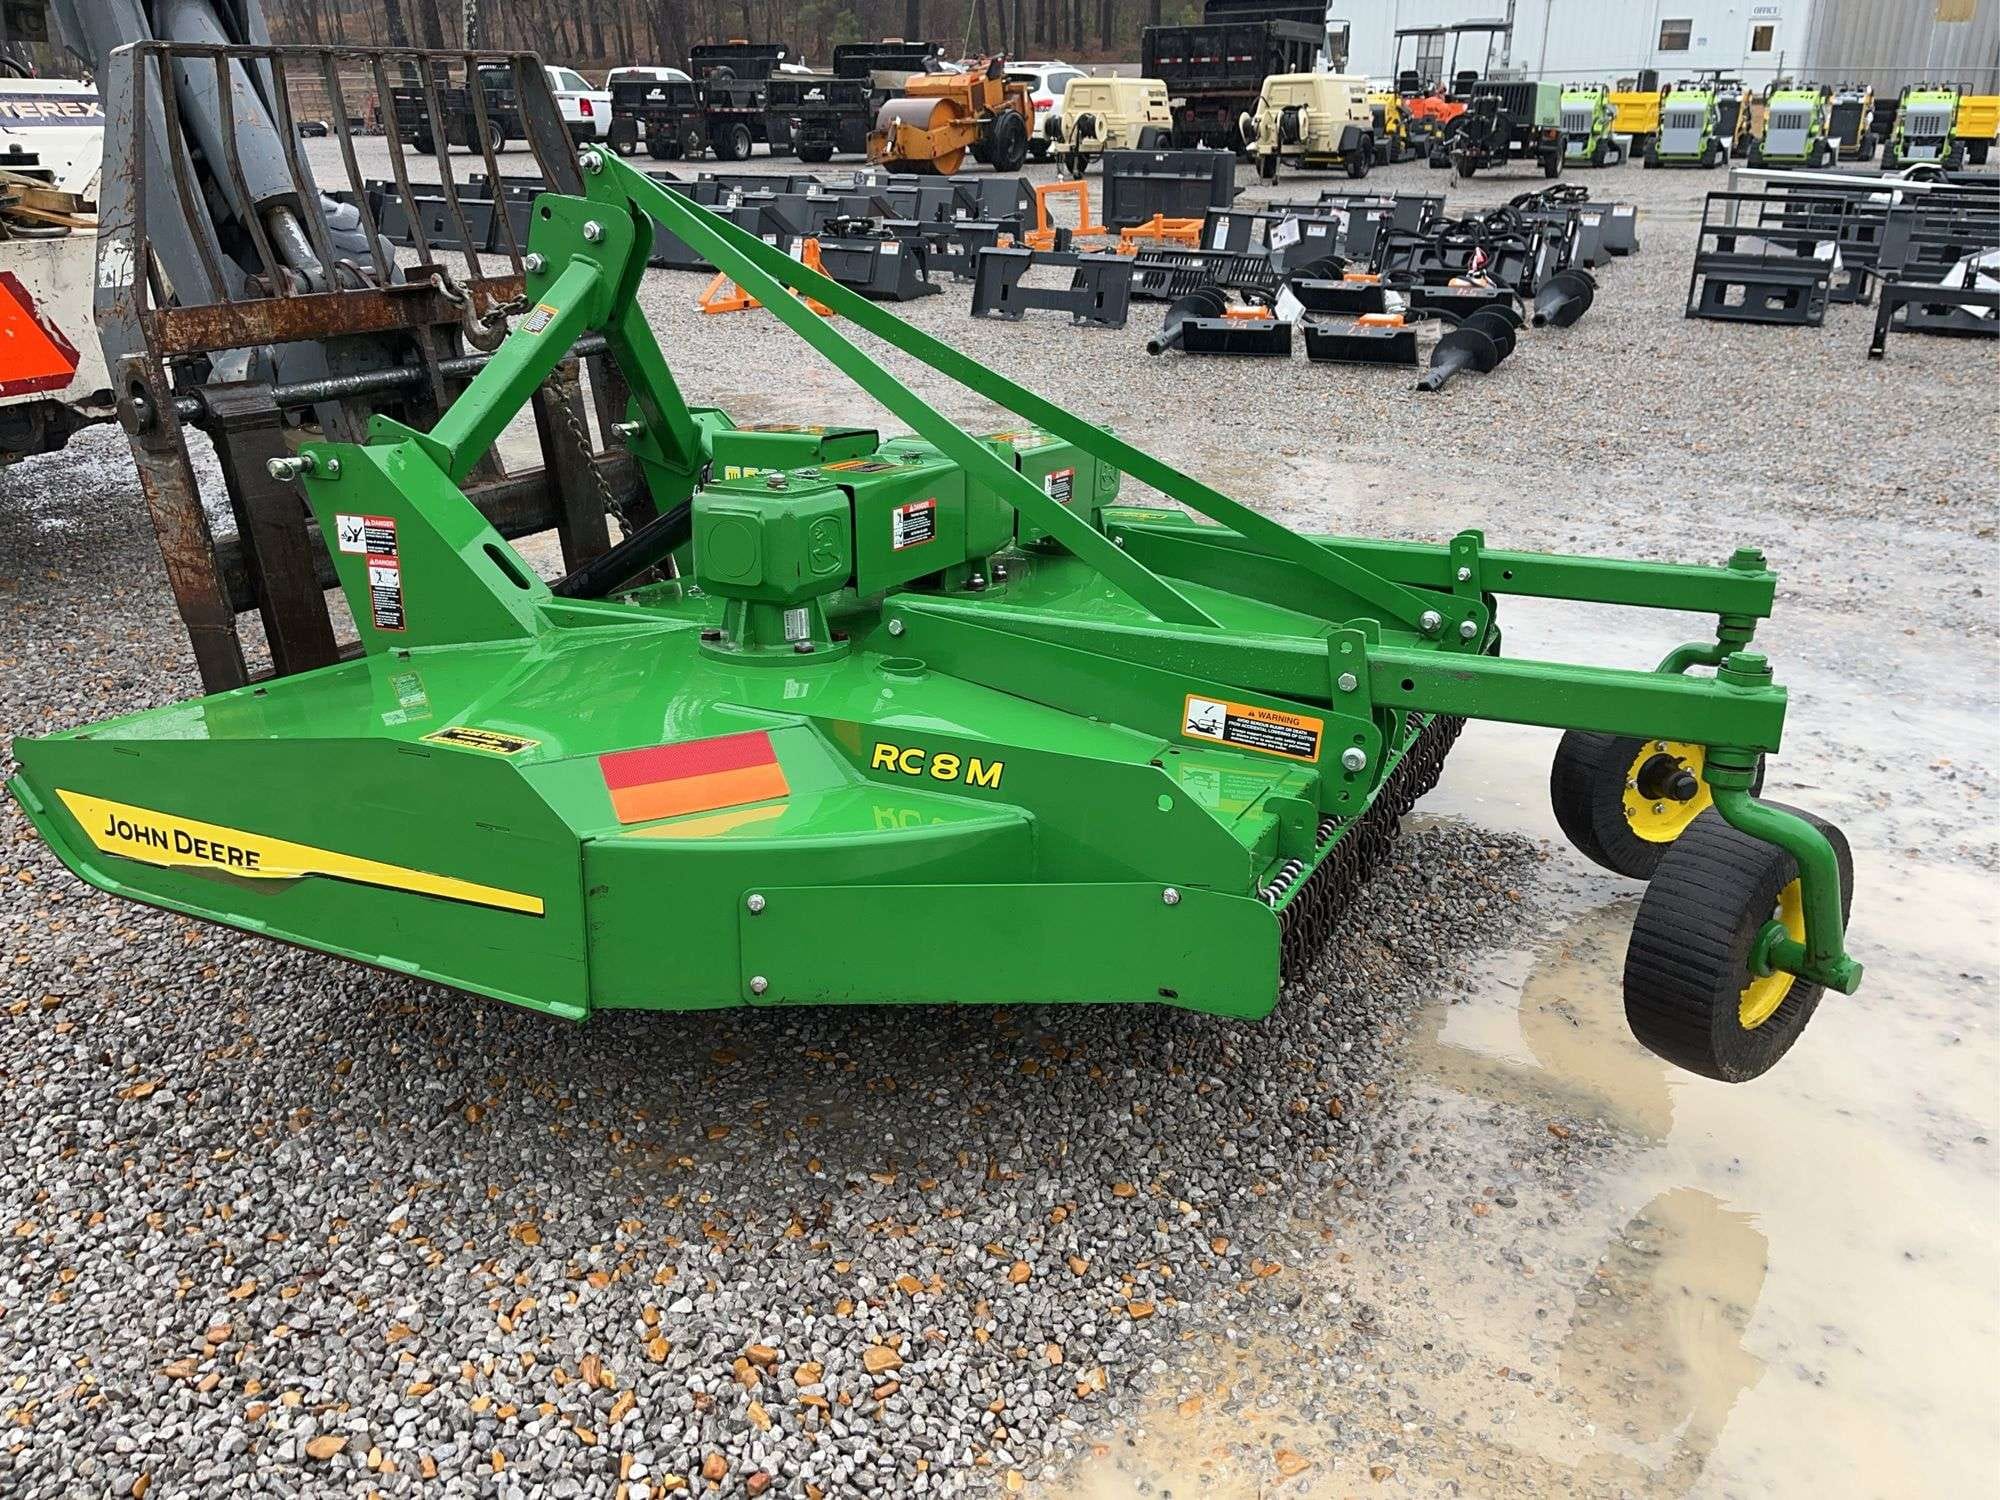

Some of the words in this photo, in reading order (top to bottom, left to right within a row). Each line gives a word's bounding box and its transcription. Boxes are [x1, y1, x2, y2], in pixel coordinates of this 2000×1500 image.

[0, 102, 105, 118] TEREX
[371, 519, 394, 527] DANGER
[374, 559, 398, 567] DANGER
[1258, 711, 1300, 726] WARNING
[105, 813, 169, 850] JOHN
[173, 829, 261, 871] DEERE
